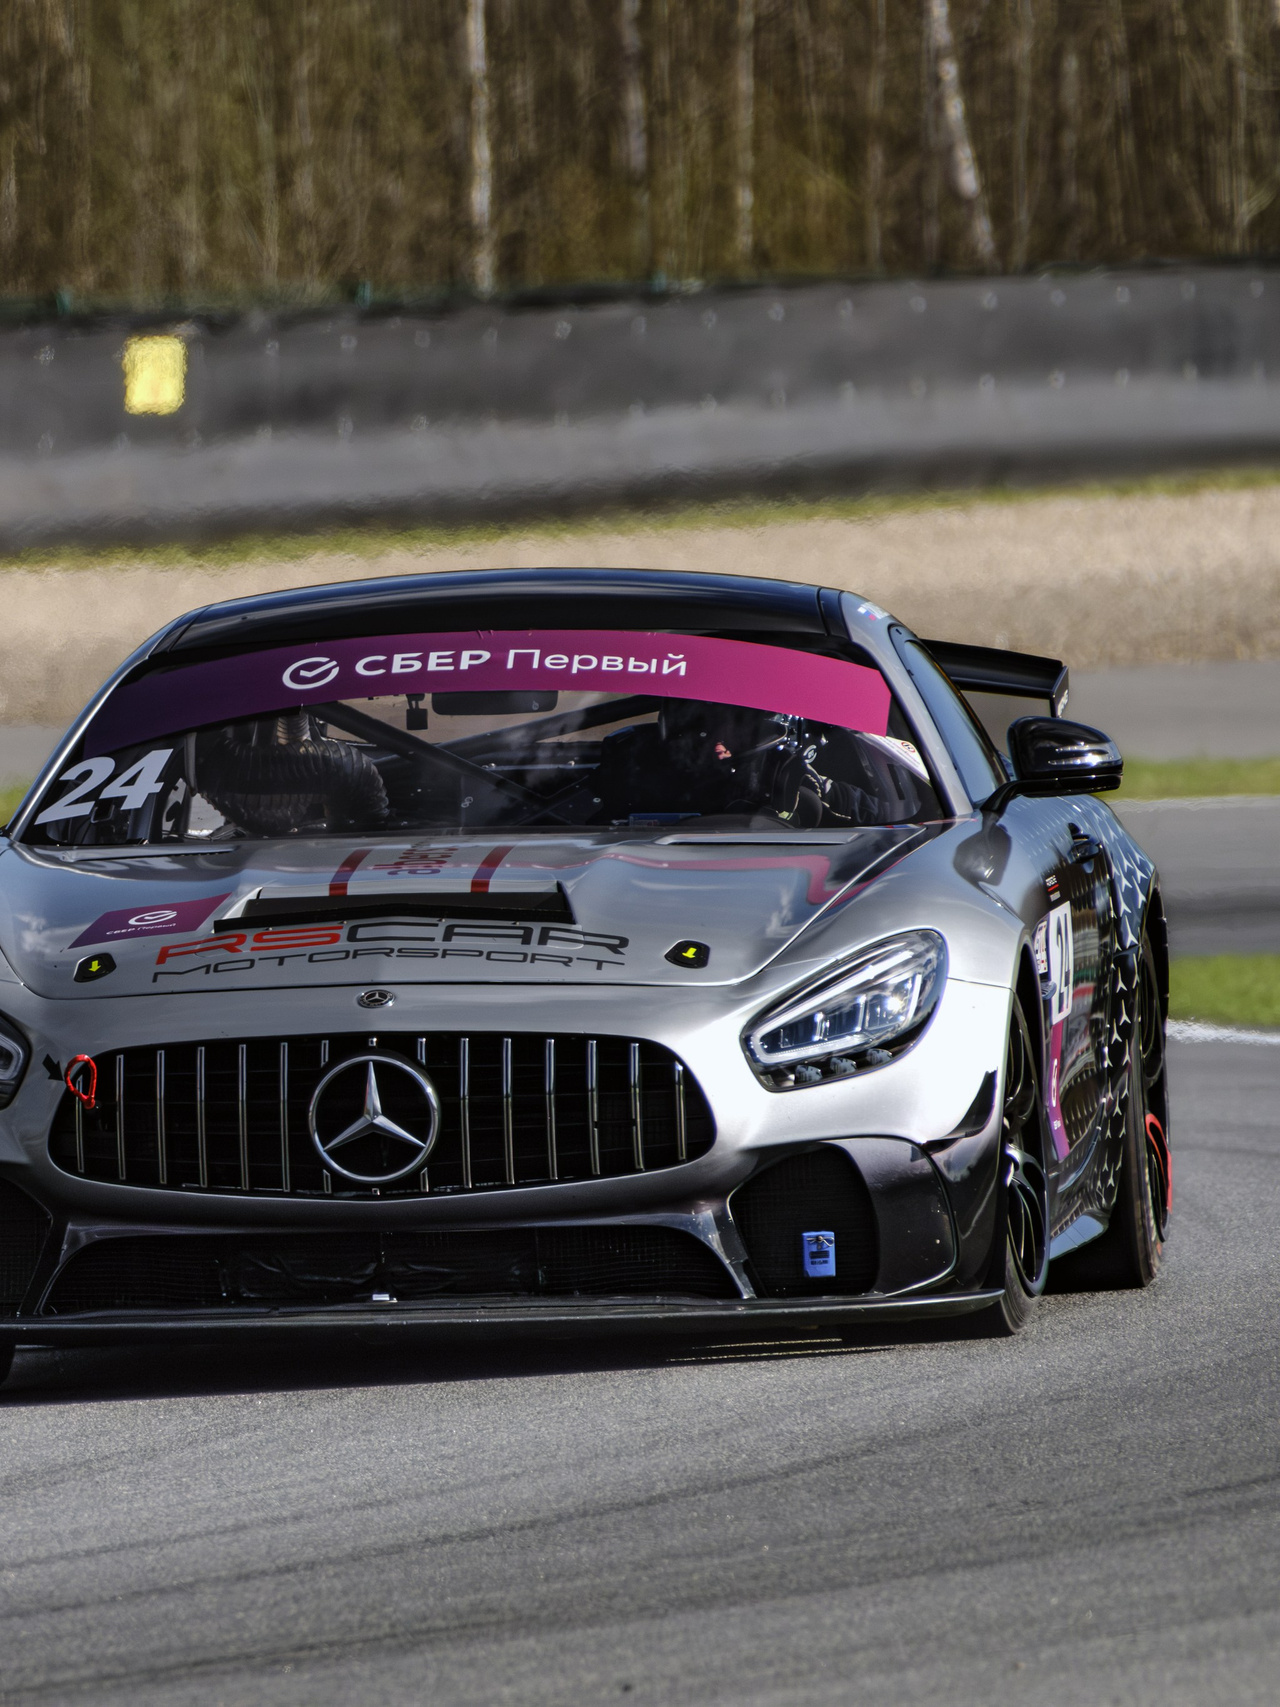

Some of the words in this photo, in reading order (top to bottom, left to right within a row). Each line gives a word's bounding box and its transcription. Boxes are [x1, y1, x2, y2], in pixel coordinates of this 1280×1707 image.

[355, 649, 491, 676] СБЕР
[506, 648, 687, 676] Первый
[34, 749, 173, 825] 24
[155, 921, 630, 965] RSCAR
[151, 947, 625, 983] MOTORSPORT
